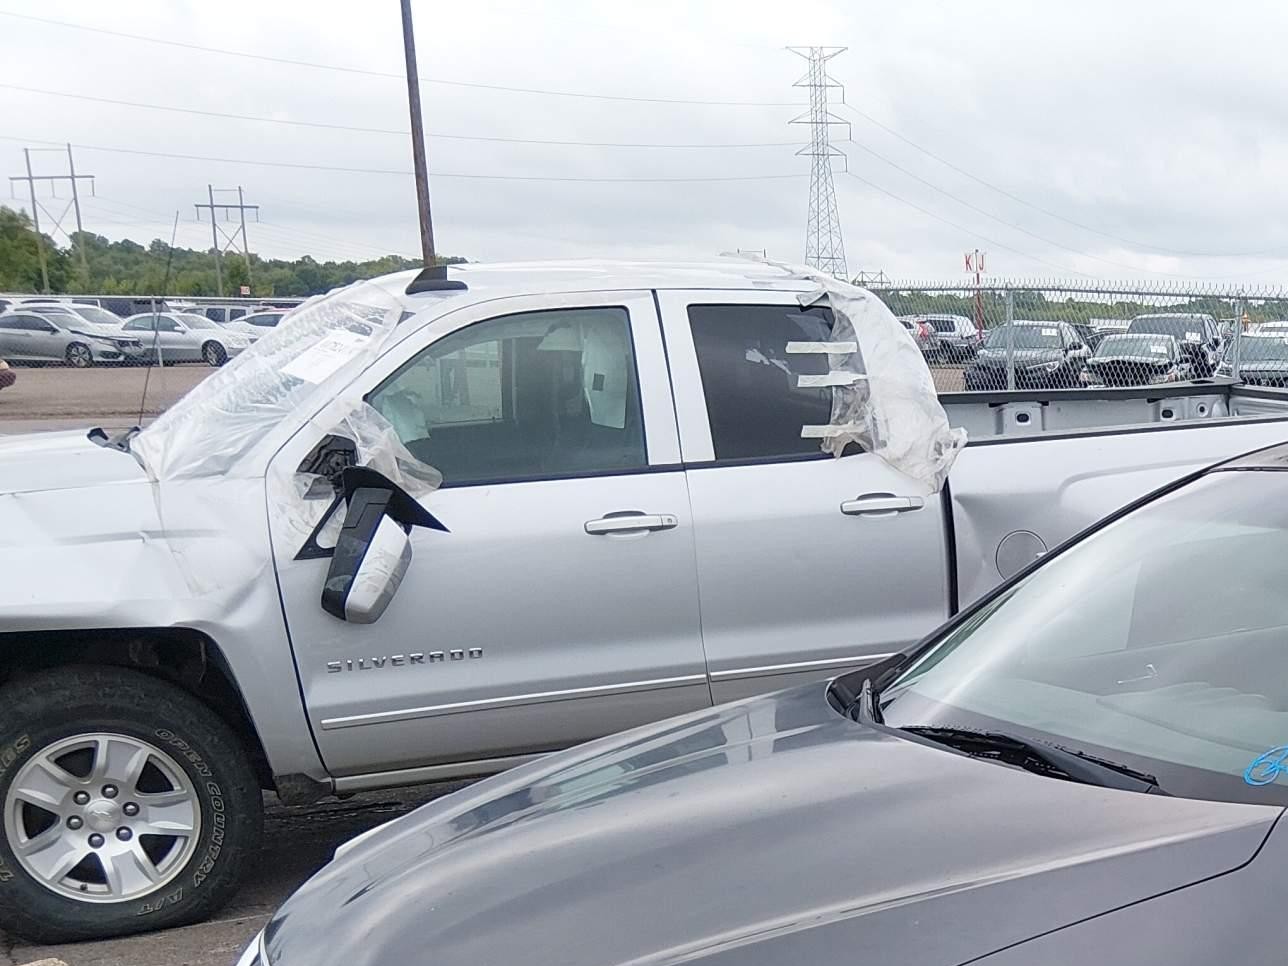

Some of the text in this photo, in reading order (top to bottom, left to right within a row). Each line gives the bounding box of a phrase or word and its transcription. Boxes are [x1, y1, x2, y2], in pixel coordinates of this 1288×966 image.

[965, 254, 984, 271] K J
[327, 648, 482, 673] SILVERADO
[154, 728, 213, 778] OPEN
[193, 782, 226, 887] COUNTRY
